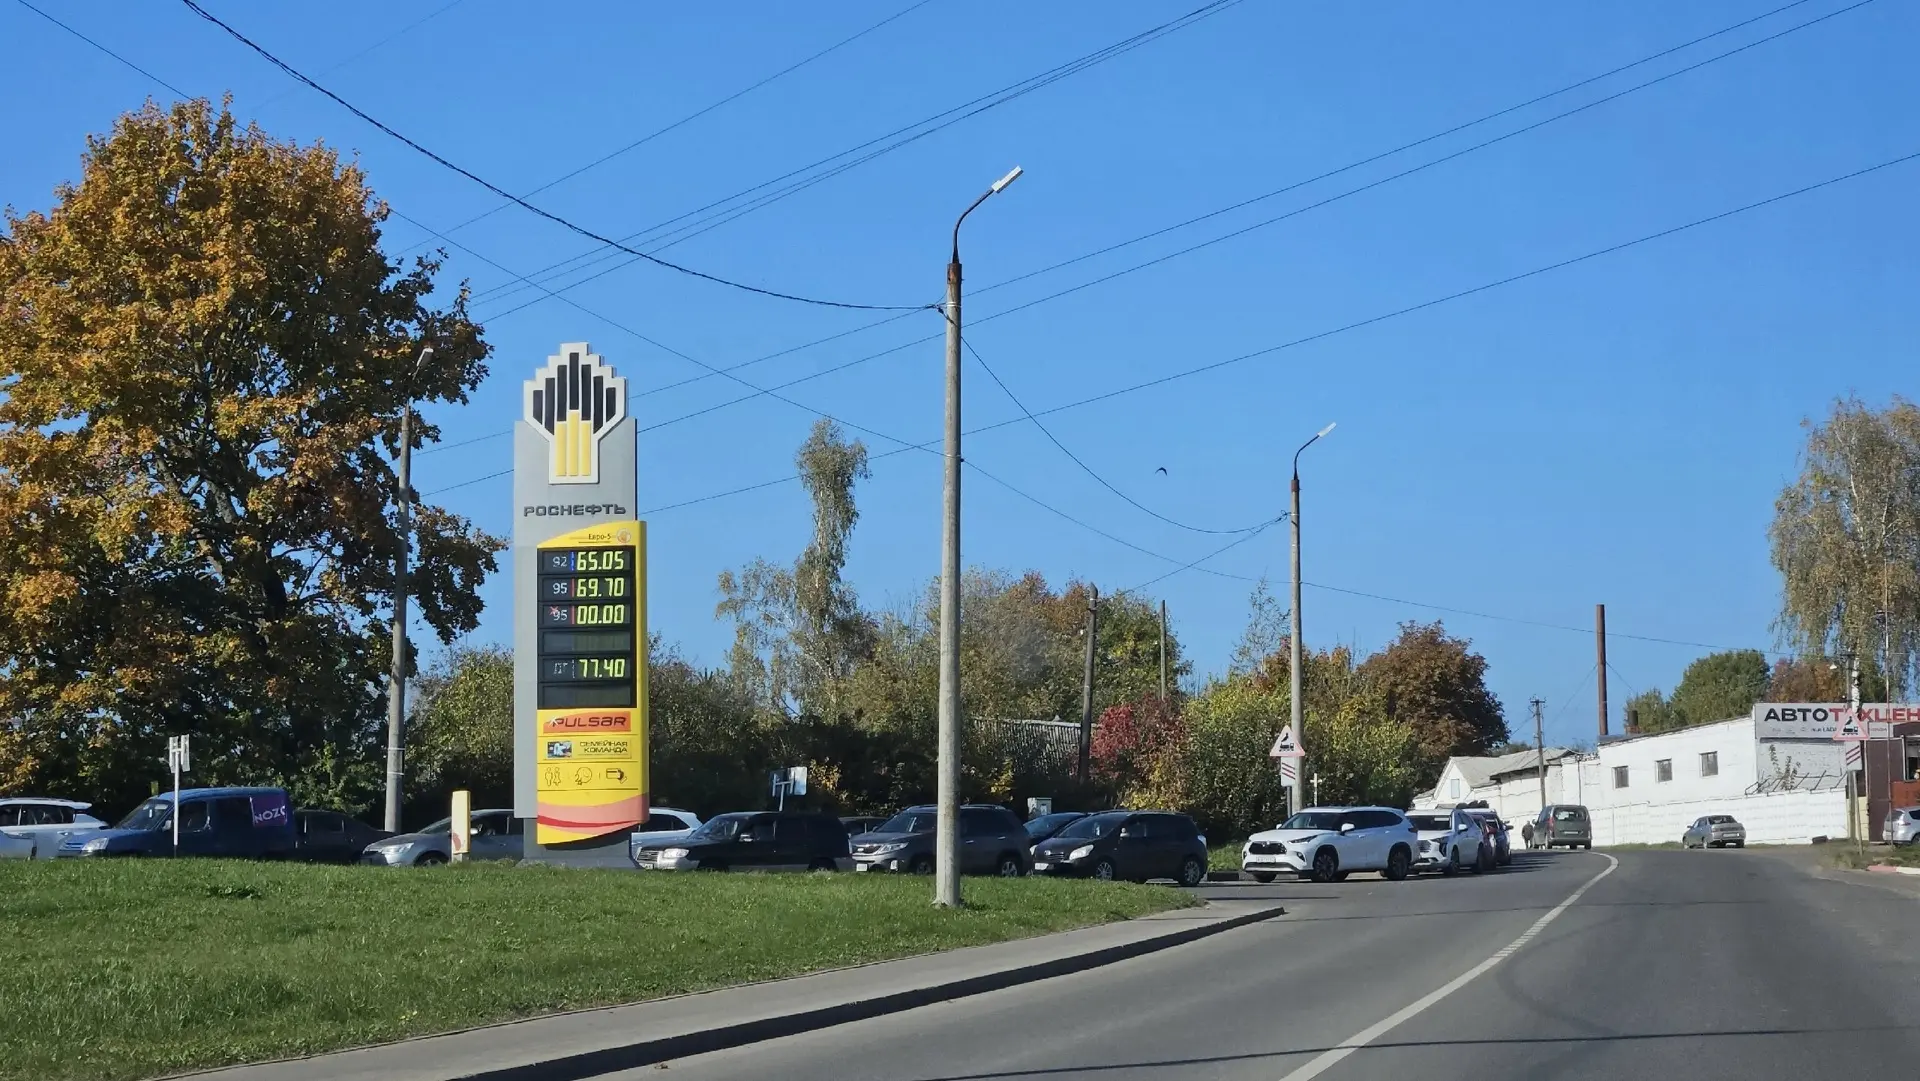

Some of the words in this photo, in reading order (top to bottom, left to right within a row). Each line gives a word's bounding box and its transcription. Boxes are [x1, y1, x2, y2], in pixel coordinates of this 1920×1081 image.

[523, 504, 627, 517] РОСНЕФТЬ
[552, 556, 568, 568] 92
[576, 550, 625, 571] 65.05
[552, 582, 568, 595] 95
[576, 577, 625, 598] 69.70
[553, 609, 568, 621] 95
[576, 604, 625, 625] 00.00
[579, 658, 625, 678] 77.40
[584, 746, 628, 754] КОМАНДА
